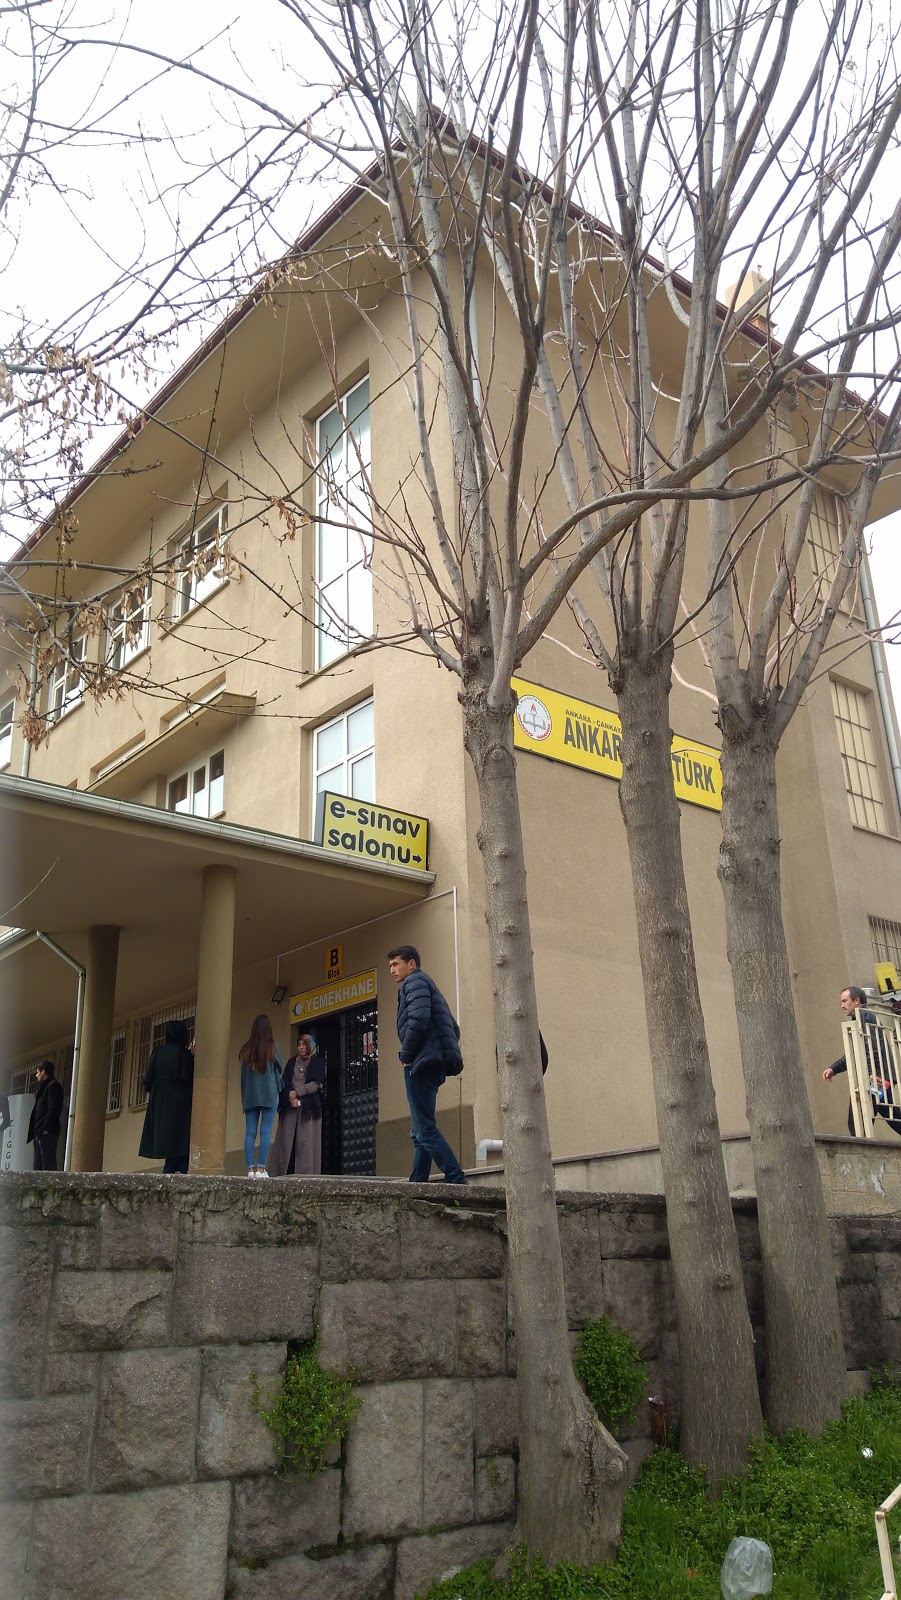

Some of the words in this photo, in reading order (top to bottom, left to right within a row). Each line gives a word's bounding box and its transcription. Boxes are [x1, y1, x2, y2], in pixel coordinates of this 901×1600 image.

[565, 709, 591, 723] ANKARA
[330, 800, 421, 838] e-sınav
[327, 829, 411, 864] salonu
[330, 947, 340, 967] B
[327, 968, 341, 980] Blok
[306, 977, 374, 1013] YEMEKHANE
